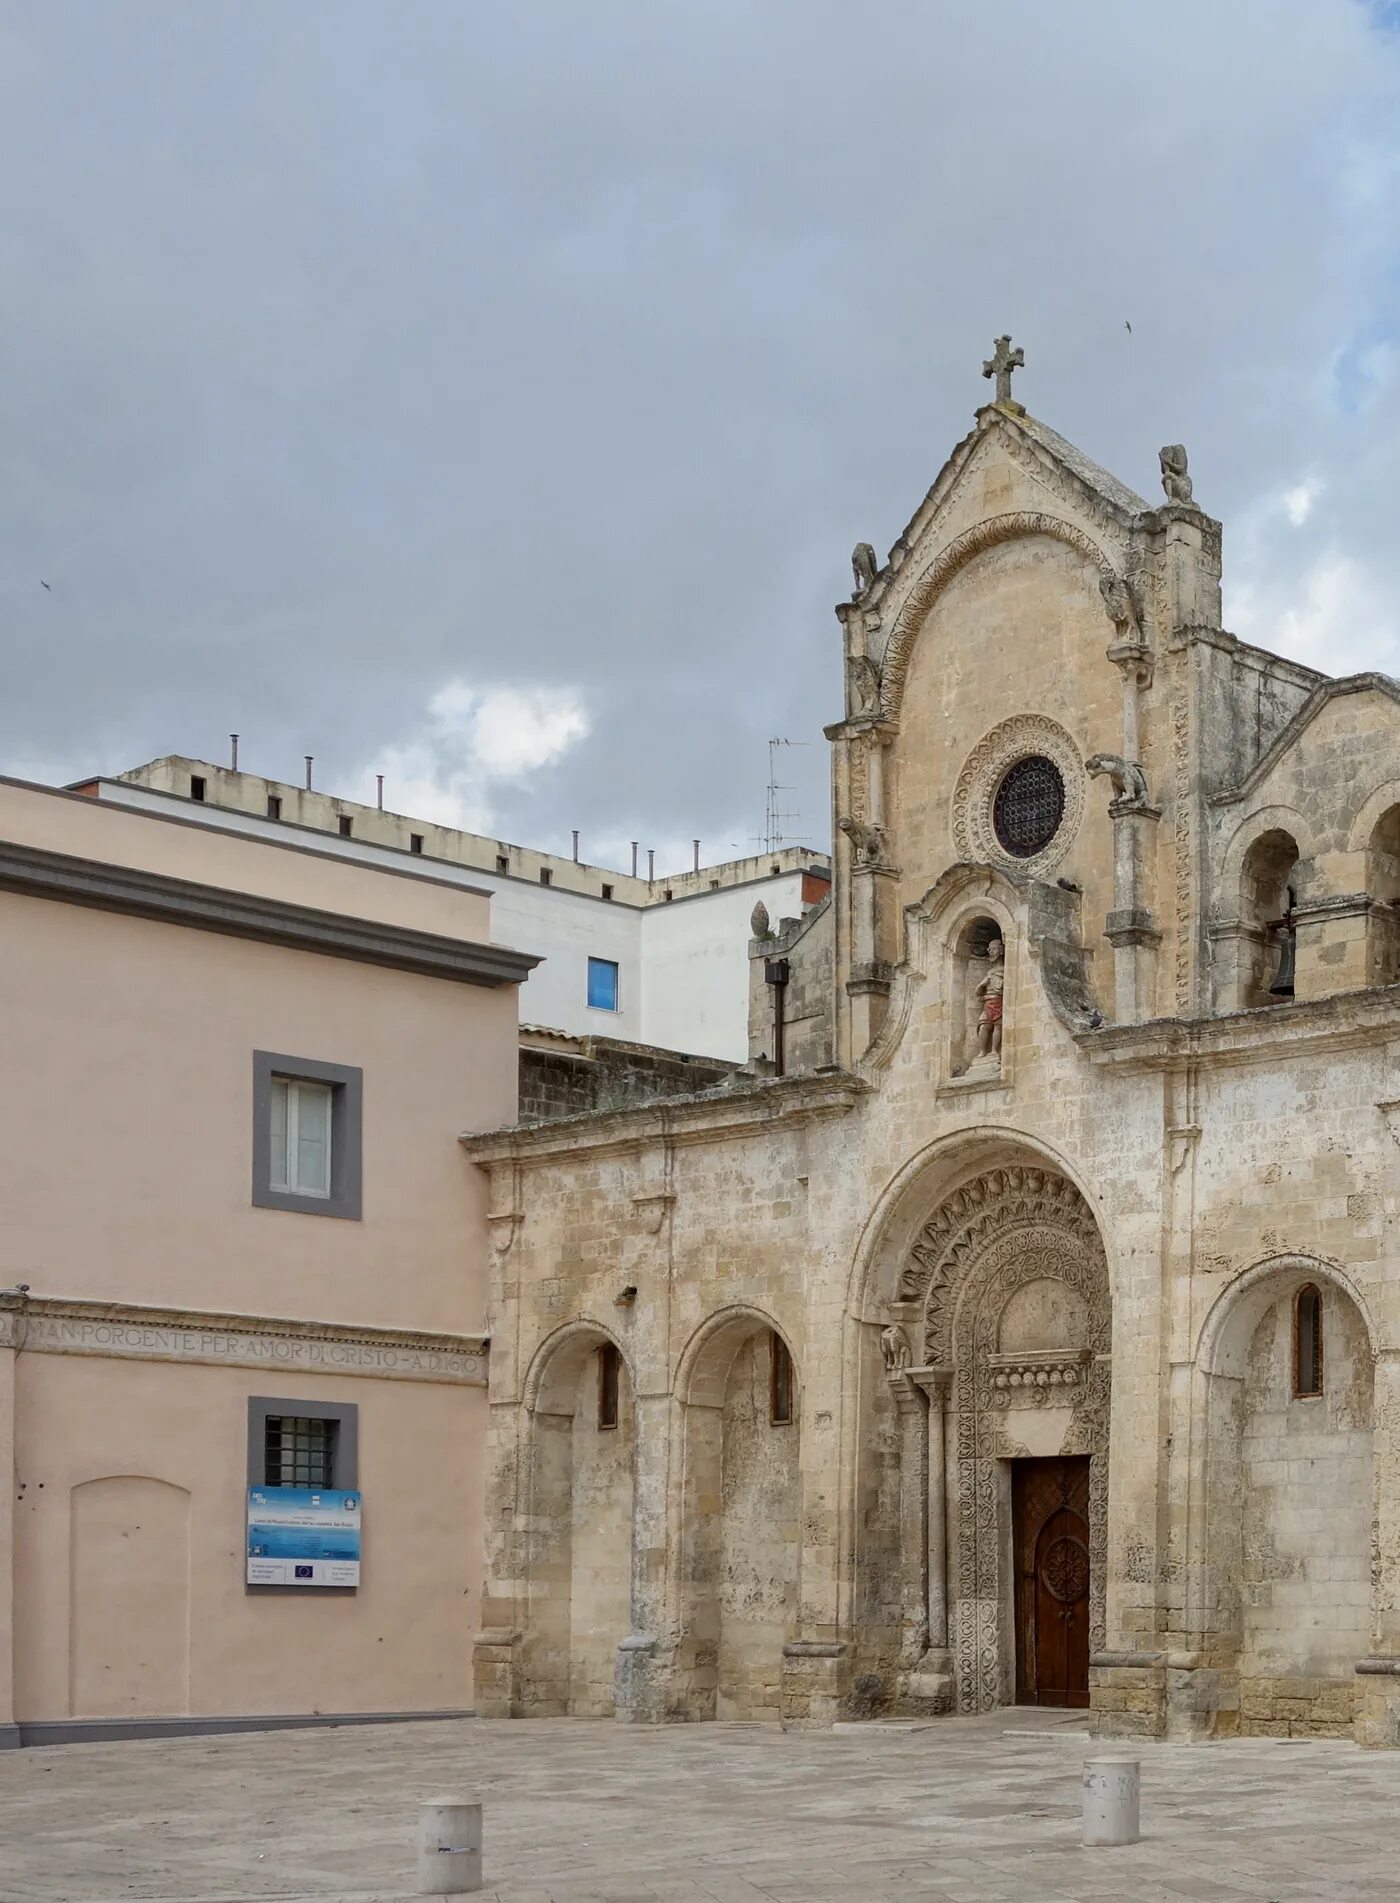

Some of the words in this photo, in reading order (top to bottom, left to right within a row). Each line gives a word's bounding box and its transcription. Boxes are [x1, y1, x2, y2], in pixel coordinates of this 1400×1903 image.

[81, 1325, 195, 1350] PORGENTE
[201, 1335, 239, 1353] PER
[246, 1339, 302, 1359] AMOR
[308, 1344, 325, 1362] DI
[331, 1346, 398, 1367] CRISTO
